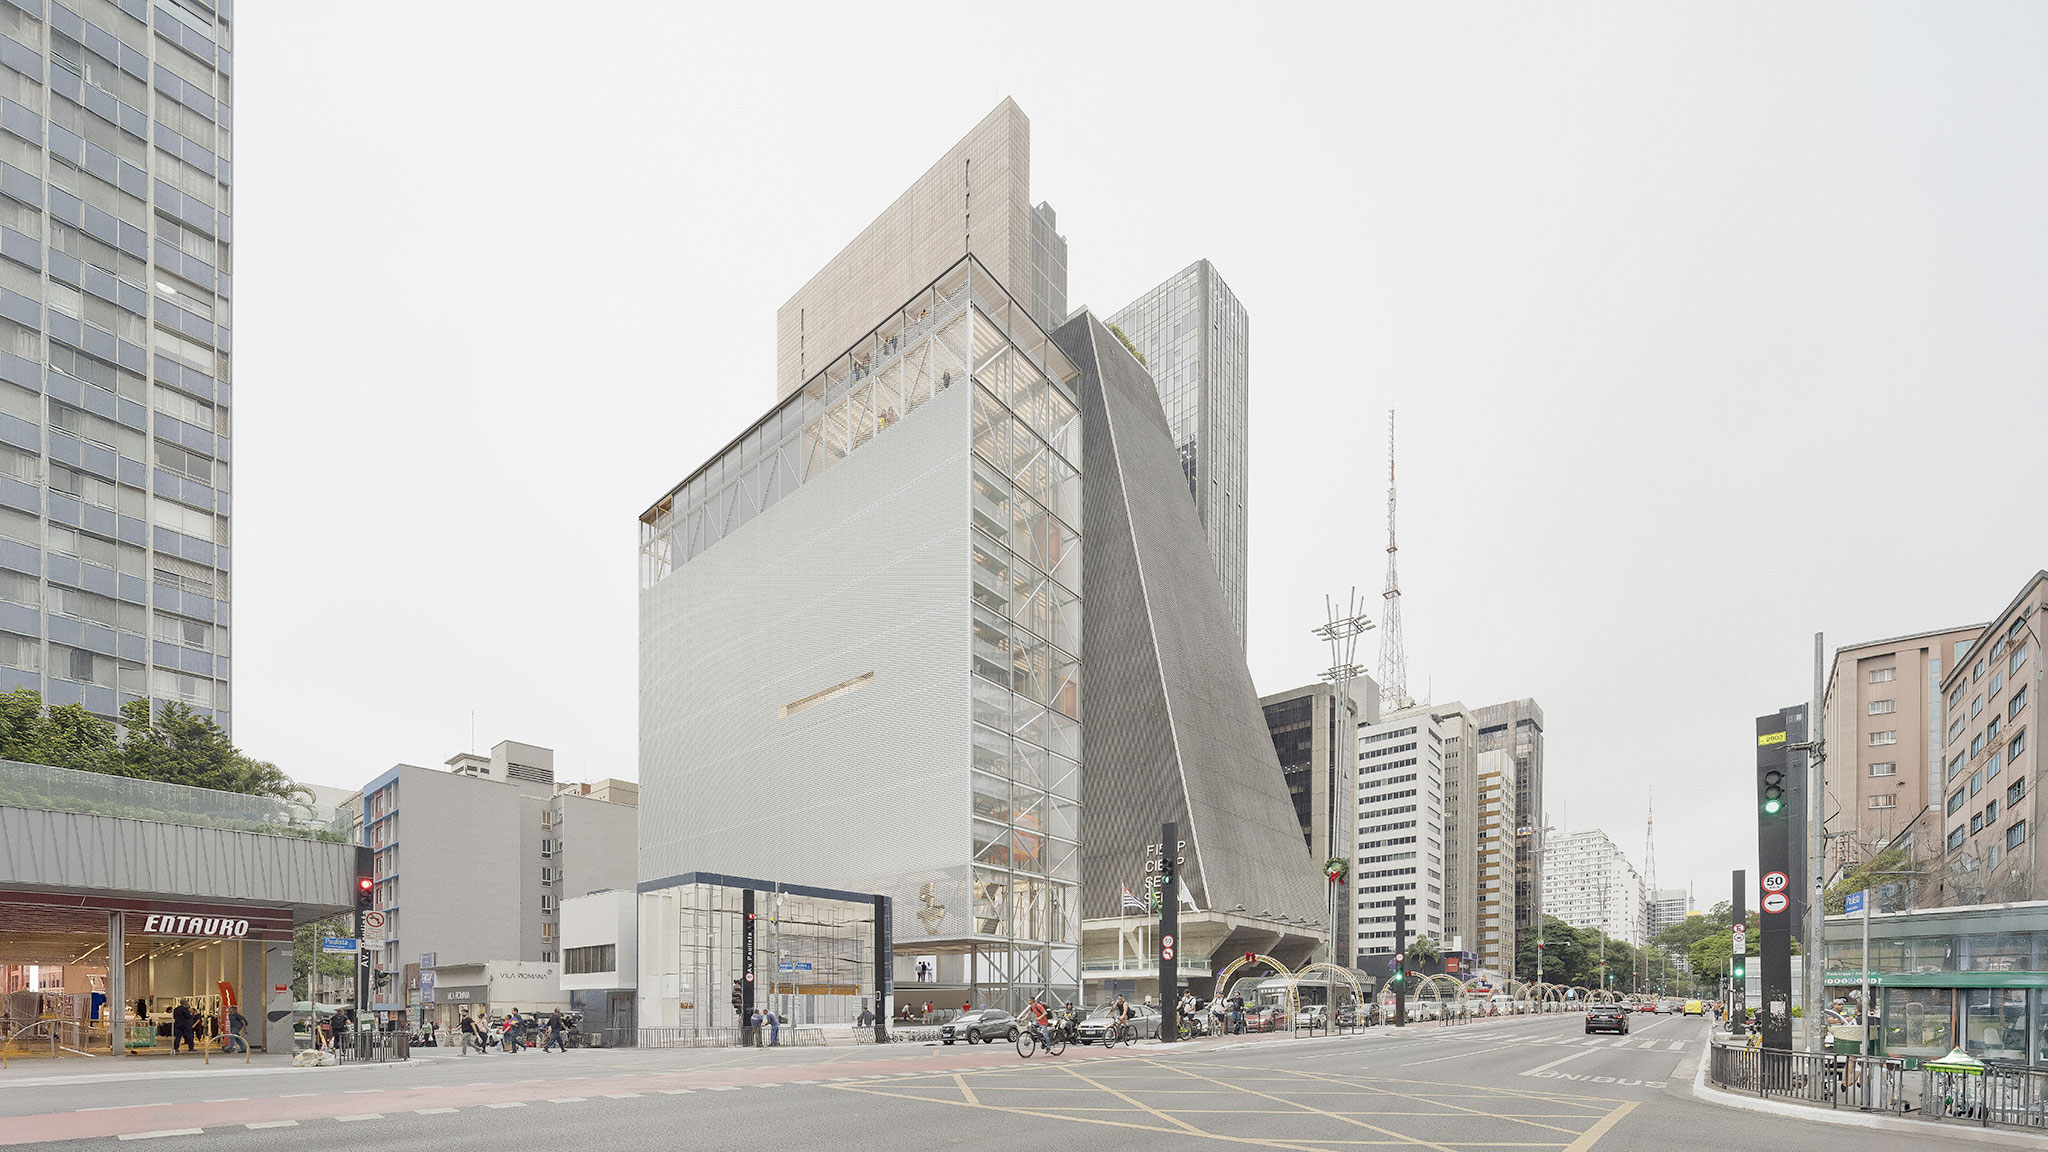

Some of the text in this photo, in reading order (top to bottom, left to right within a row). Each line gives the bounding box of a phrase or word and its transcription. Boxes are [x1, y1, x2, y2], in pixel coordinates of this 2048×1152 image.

[1146, 840, 1186, 857] FIEP
[1145, 857, 1185, 873] CIEP
[1766, 876, 1783, 886] 50
[143, 914, 249, 938] ENTAURO
[360, 952, 369, 968] Av.
